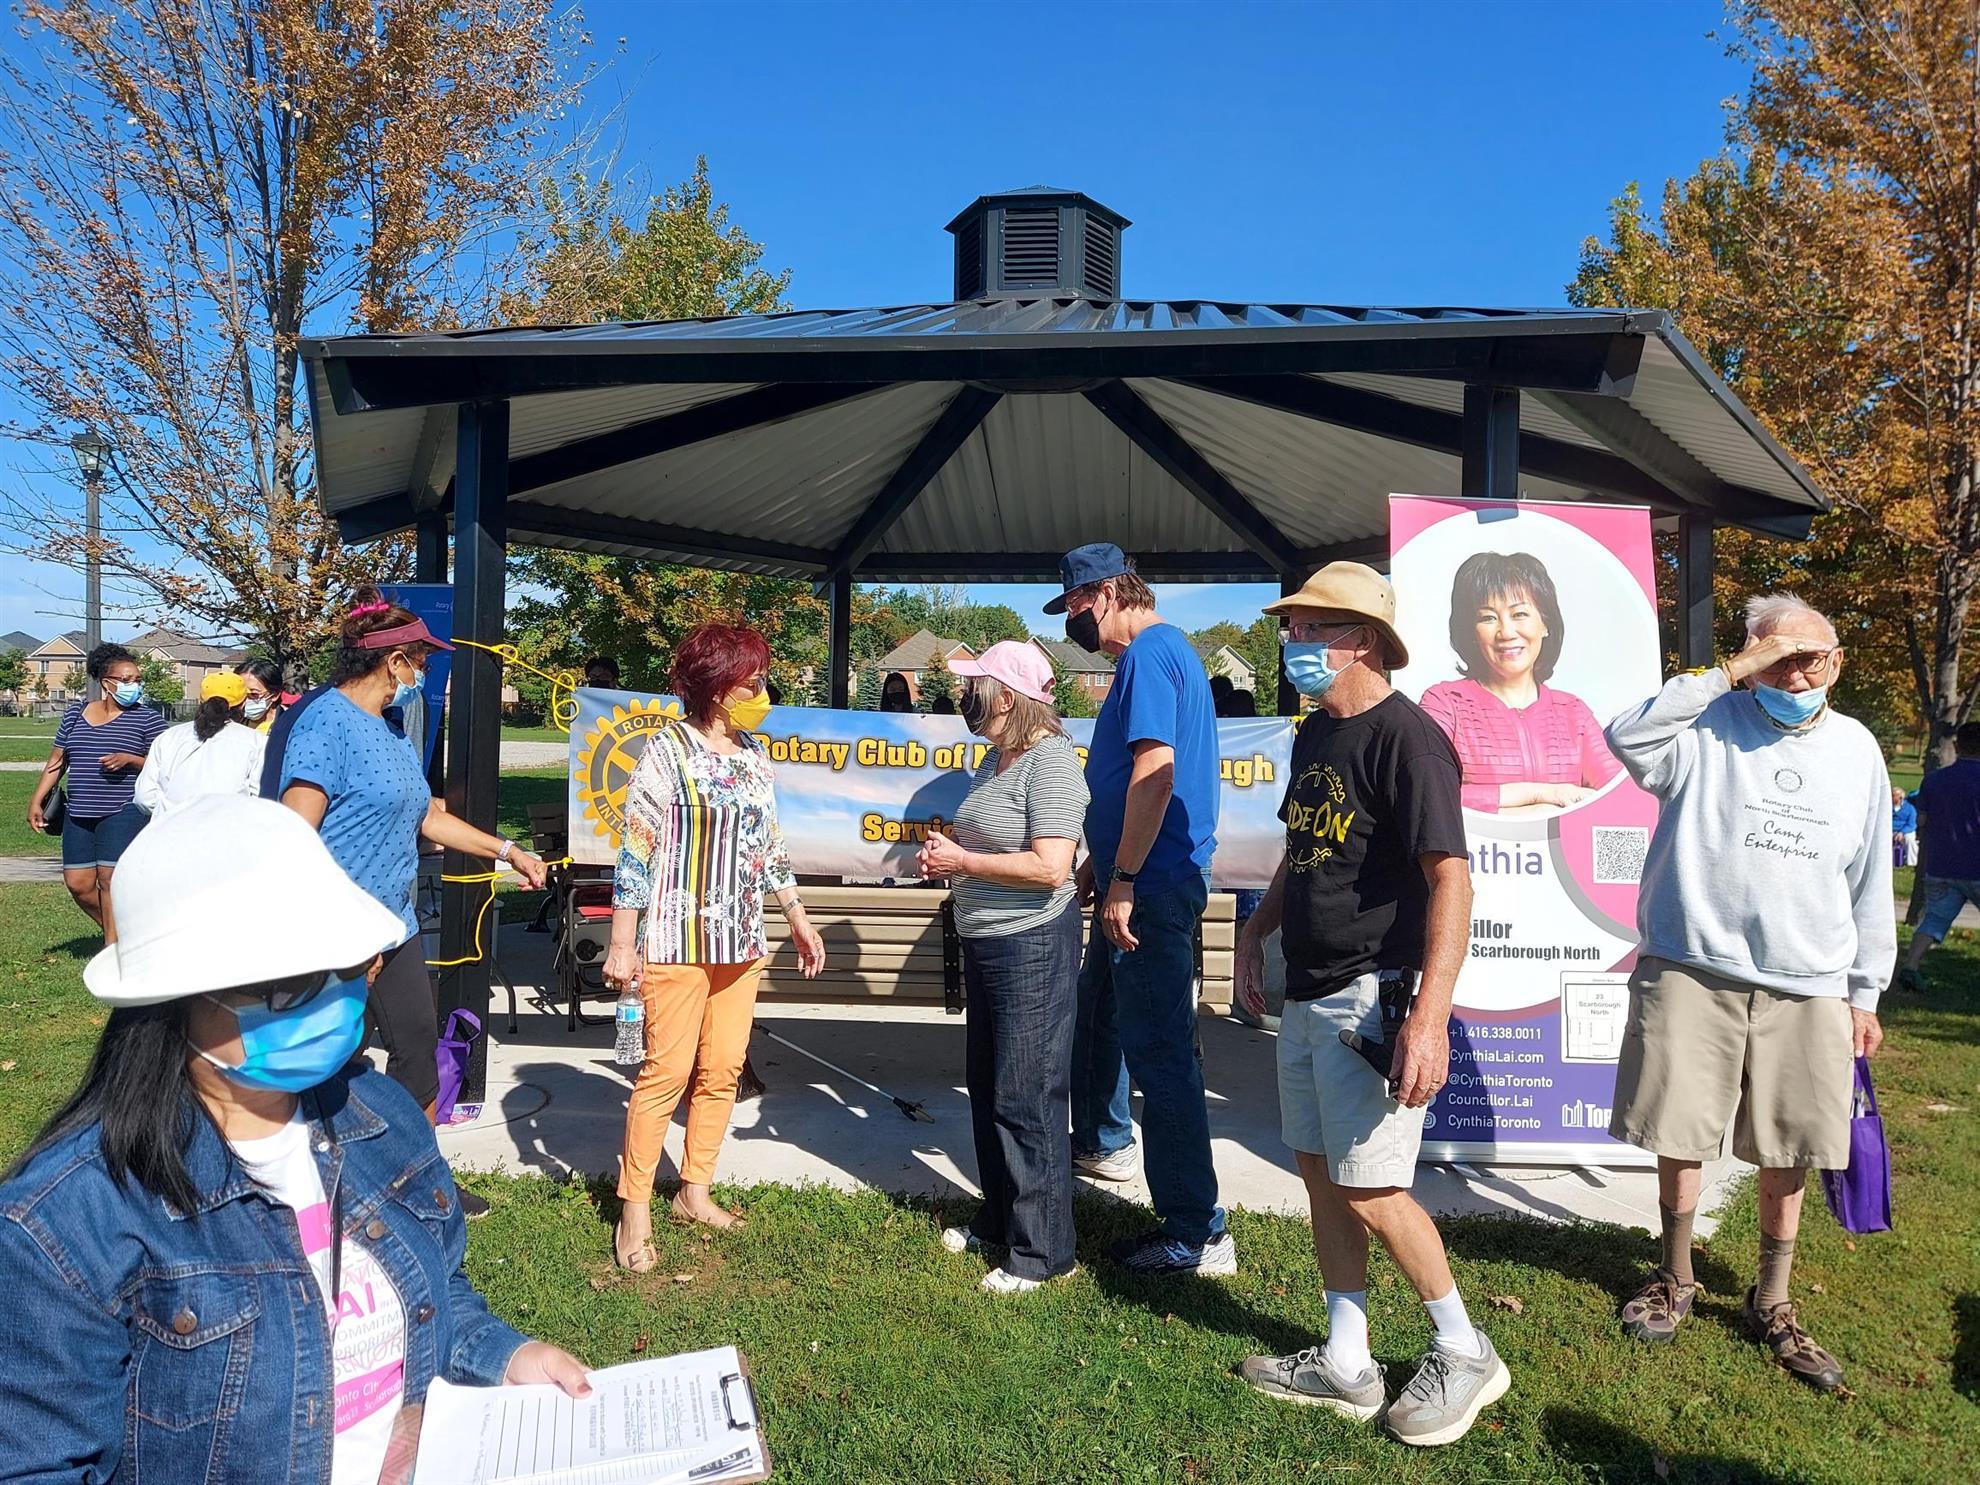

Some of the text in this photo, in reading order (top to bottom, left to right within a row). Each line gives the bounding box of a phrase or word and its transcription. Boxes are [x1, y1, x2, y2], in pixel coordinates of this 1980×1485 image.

[857, 738, 927, 768] Club
[934, 743, 966, 769] of
[1762, 798, 1814, 813] Rotary Club
[1744, 804, 1830, 826] North Scarborough
[1763, 820, 1806, 845] Camp
[1744, 833, 1820, 860] Enterprise
[1471, 943, 1600, 960] Scarborough North
[1579, 1001, 1621, 1009] Scarborough
[1450, 1026, 1541, 1040] +1.416.338.0011
[1450, 1049, 1544, 1064] CynthiaLai.com
[1449, 1073, 1553, 1088] @CynthiaToronto
[1449, 1094, 1533, 1107] Councillor.Lai
[1449, 1115, 1541, 1129] CynthiaToronto
